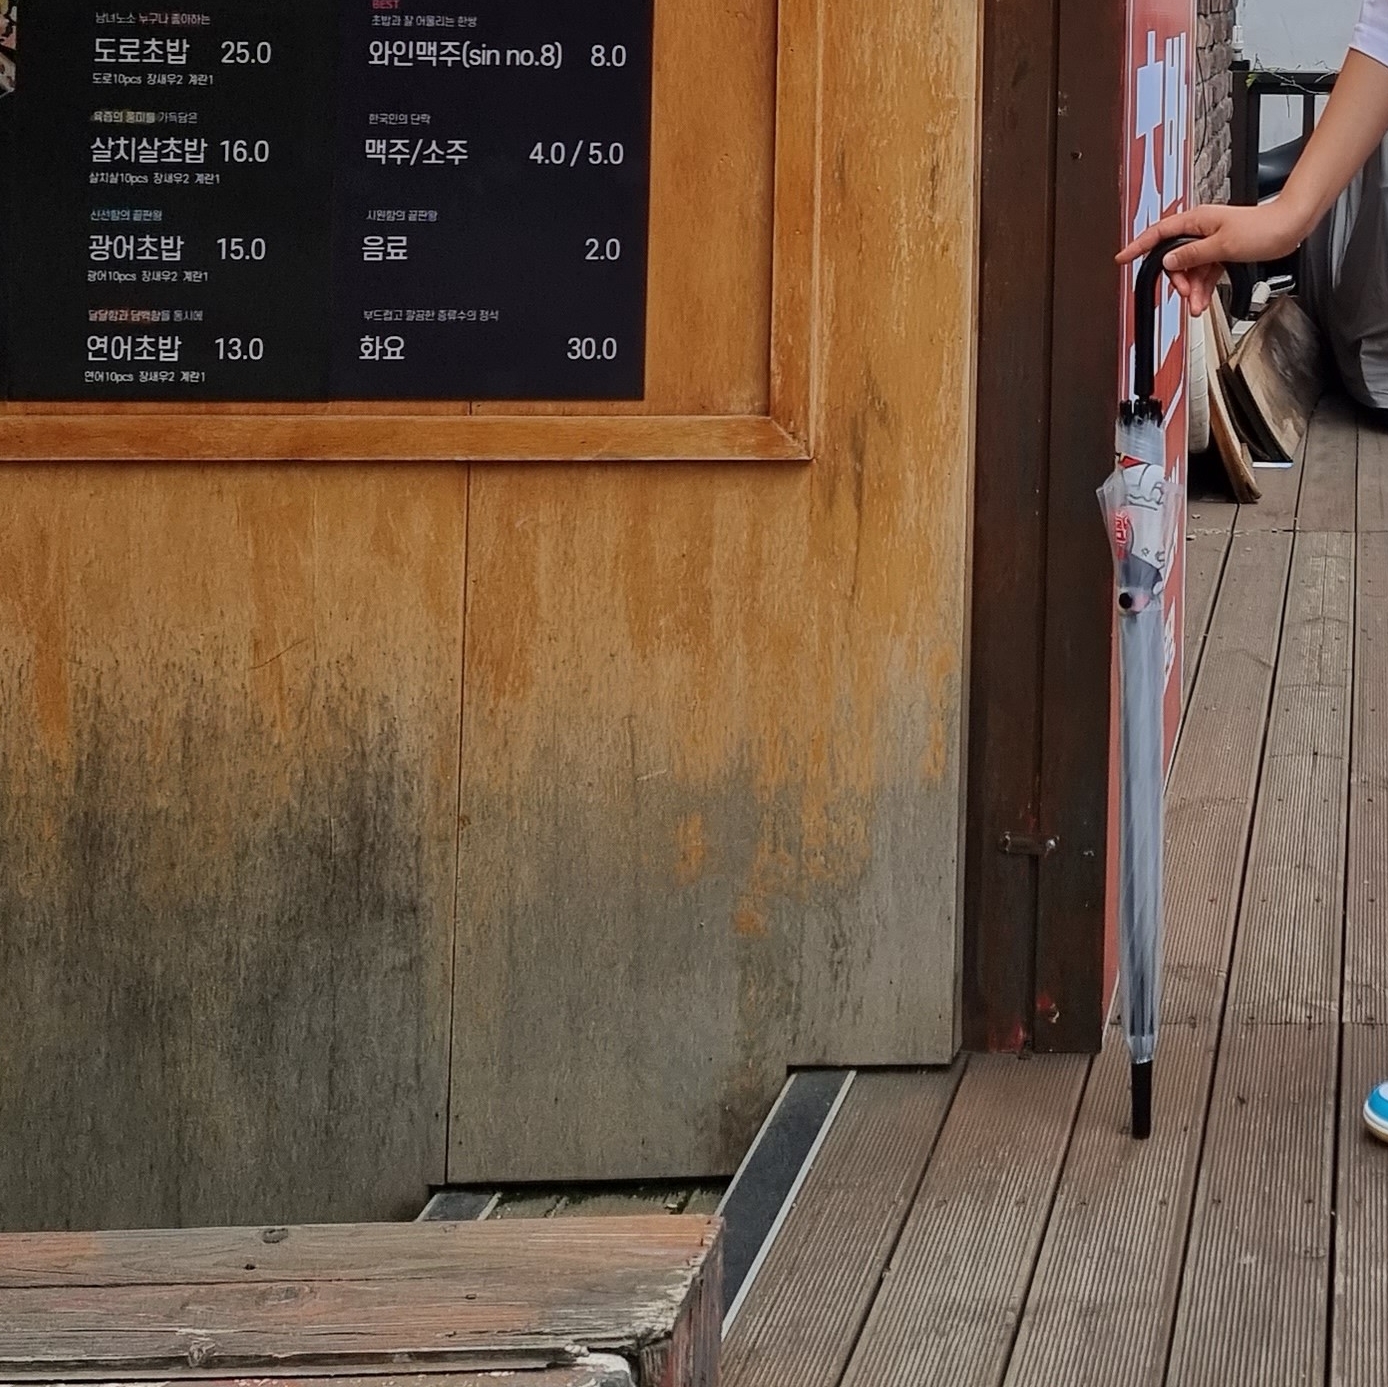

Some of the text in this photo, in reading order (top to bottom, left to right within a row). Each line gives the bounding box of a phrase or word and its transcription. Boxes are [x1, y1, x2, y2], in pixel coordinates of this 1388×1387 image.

[371, 15, 401, 27] 초밥과
[416, 16, 455, 27] 어울리는
[93, 38, 272, 65] 도로초밥 25.0
[368, 40, 627, 70] 와인맥주(sin no.8) 8.0
[92, 72, 214, 86] 도로10pcs 장새우2 계란1
[368, 113, 408, 125] 한국인의
[90, 136, 270, 164] 살치살초밥 16.0
[364, 138, 624, 168] 맥주/소주 4.0 / 5.0
[153, 172, 190, 184] 장새우2
[194, 172, 220, 184] 계란1
[88, 234, 266, 262] 광어초밥 15.0
[362, 235, 621, 262] 음료 2.0
[87, 270, 208, 284] 광어10pcs 장새우2 계란1
[86, 335, 264, 362] 연어초밥 13.0
[358, 334, 618, 361] 화요 30.0
[84, 370, 205, 384] 연어10pcs 장새우2 계란1
